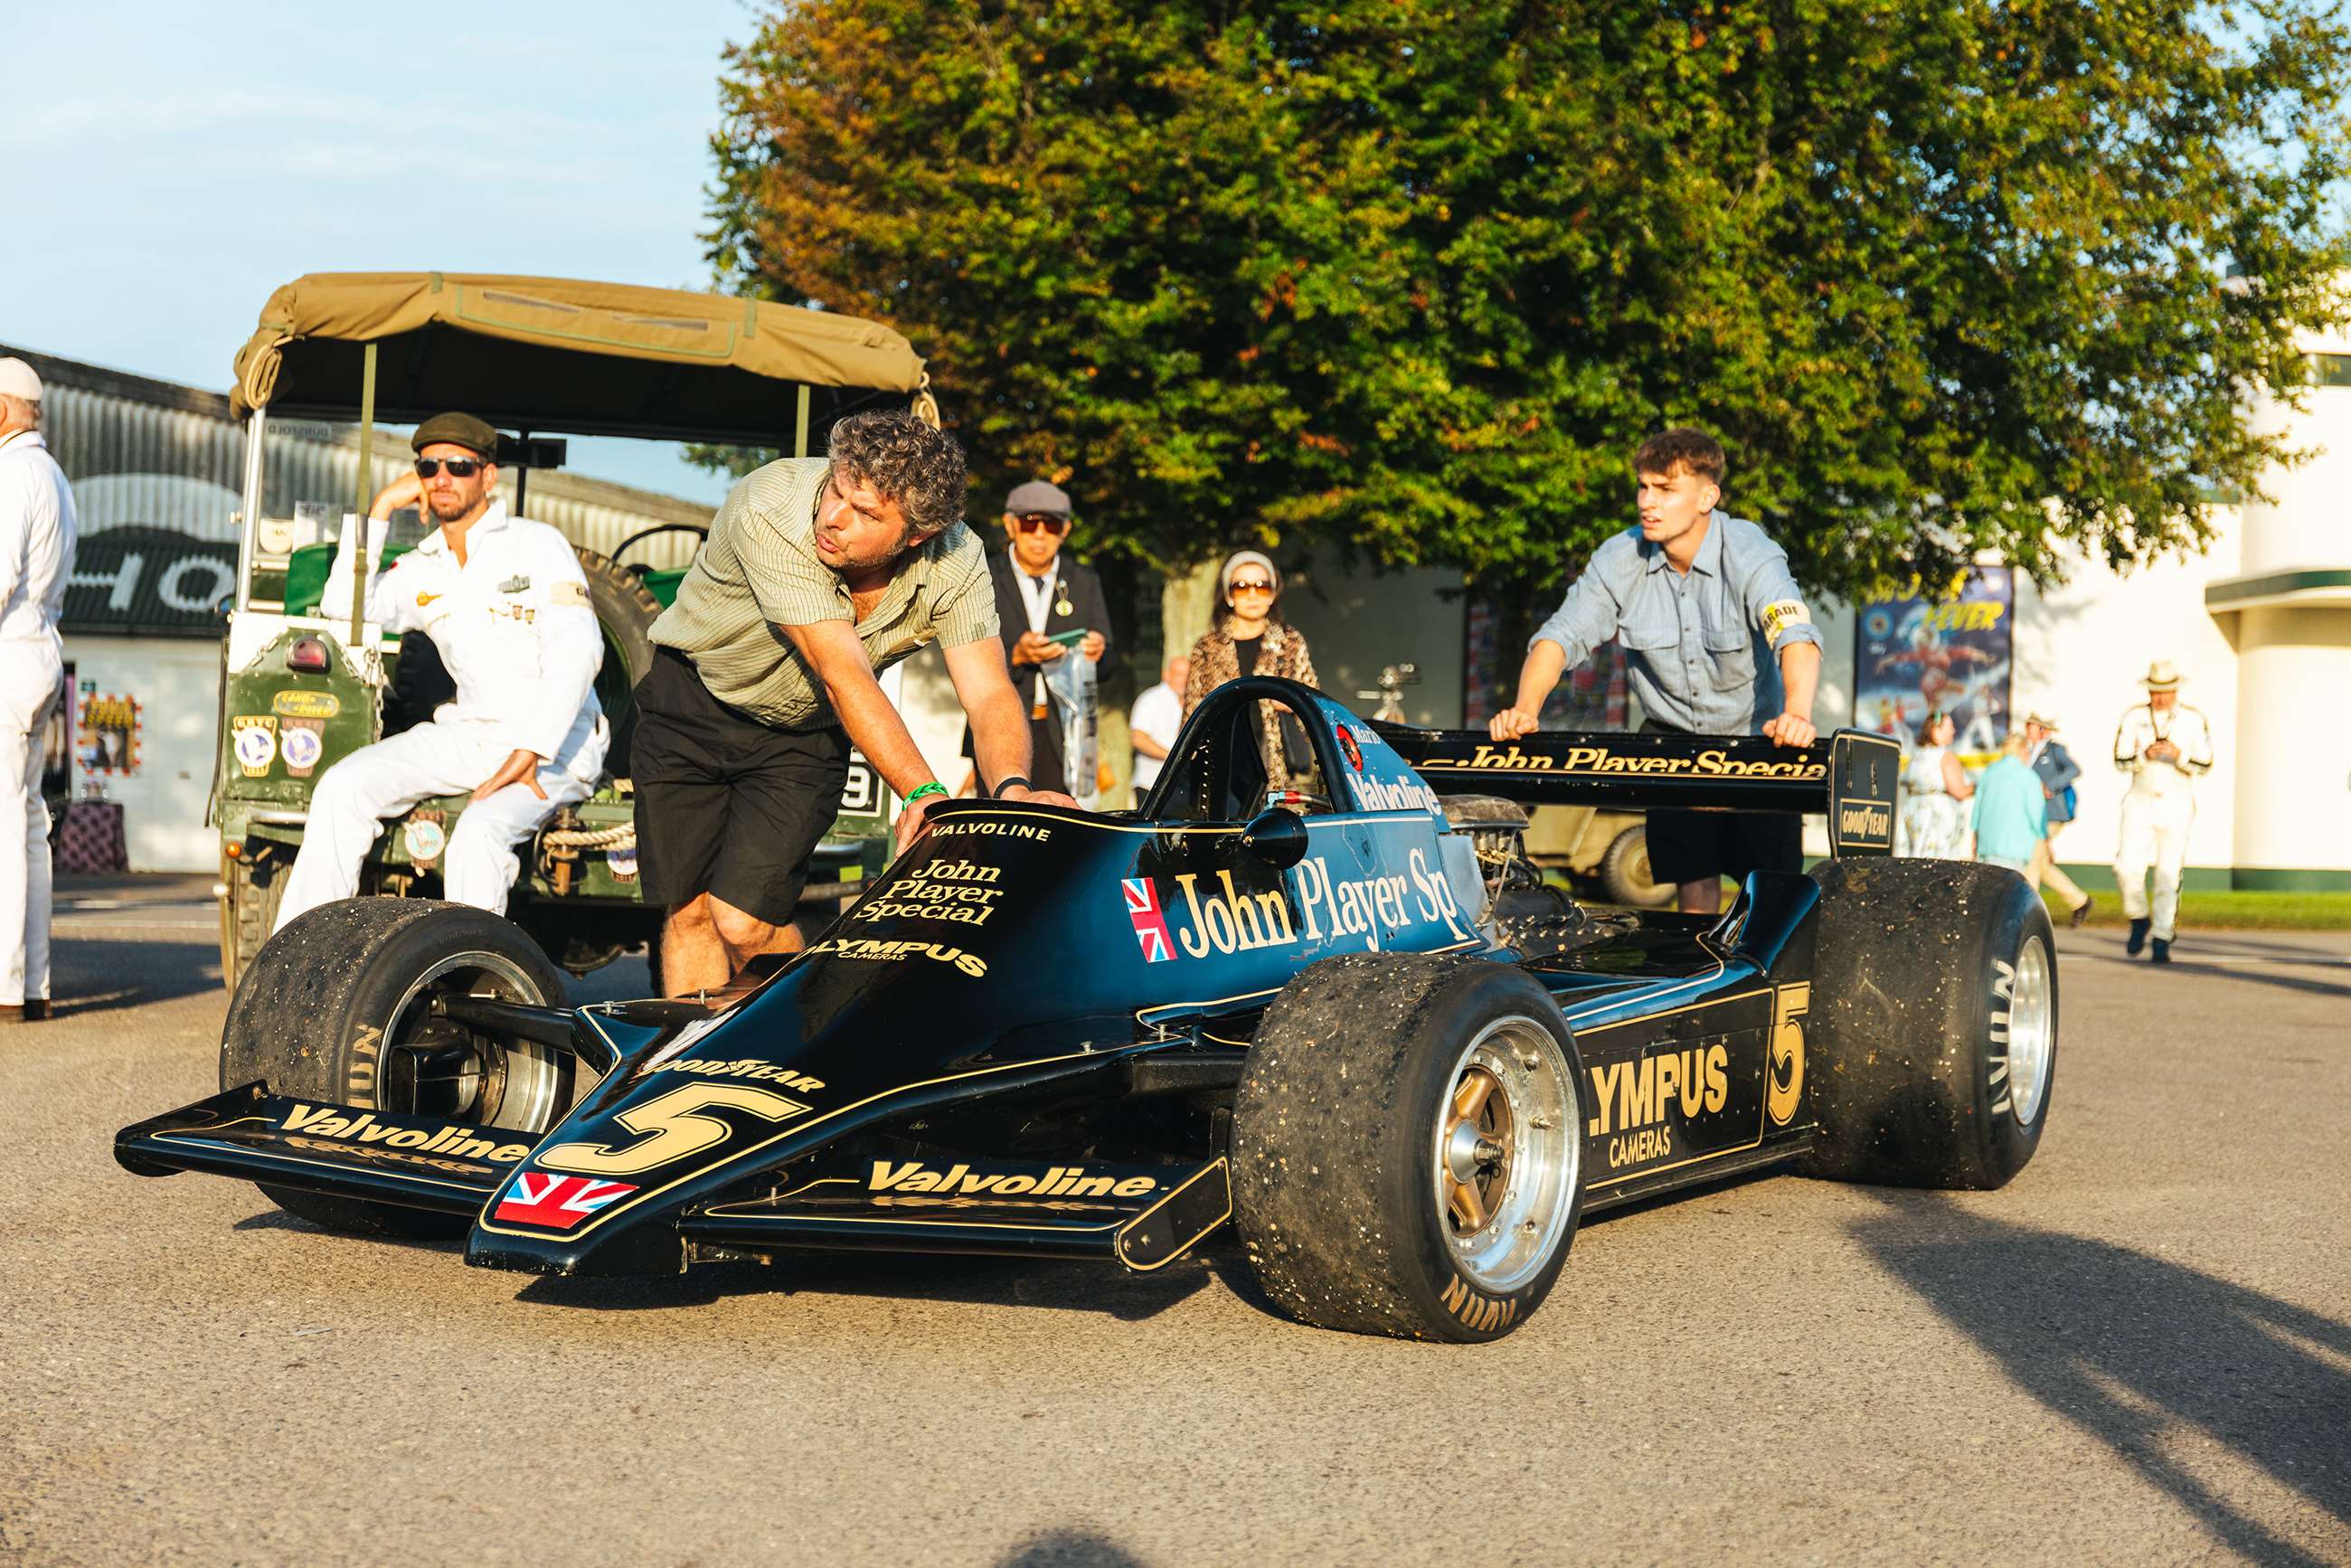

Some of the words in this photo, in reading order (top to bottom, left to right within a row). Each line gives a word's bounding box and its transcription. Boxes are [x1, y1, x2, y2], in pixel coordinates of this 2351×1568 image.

[1345, 773, 1442, 816] Valvoline
[931, 822, 1052, 842] VALVOLINE
[911, 859, 1002, 883] John
[879, 879, 1004, 904] Player
[1176, 869, 1297, 959] John
[1296, 856, 1412, 952] Player
[1410, 847, 1468, 940] Sp
[853, 900, 995, 926] Special
[837, 951, 907, 961] CAMERAS
[1768, 980, 1810, 1126] 5
[280, 1104, 530, 1162] Valvoline
[533, 1082, 814, 1176] 5
[1610, 1125, 1671, 1168] CAMERAS
[868, 1161, 1157, 1197] Valvoline
